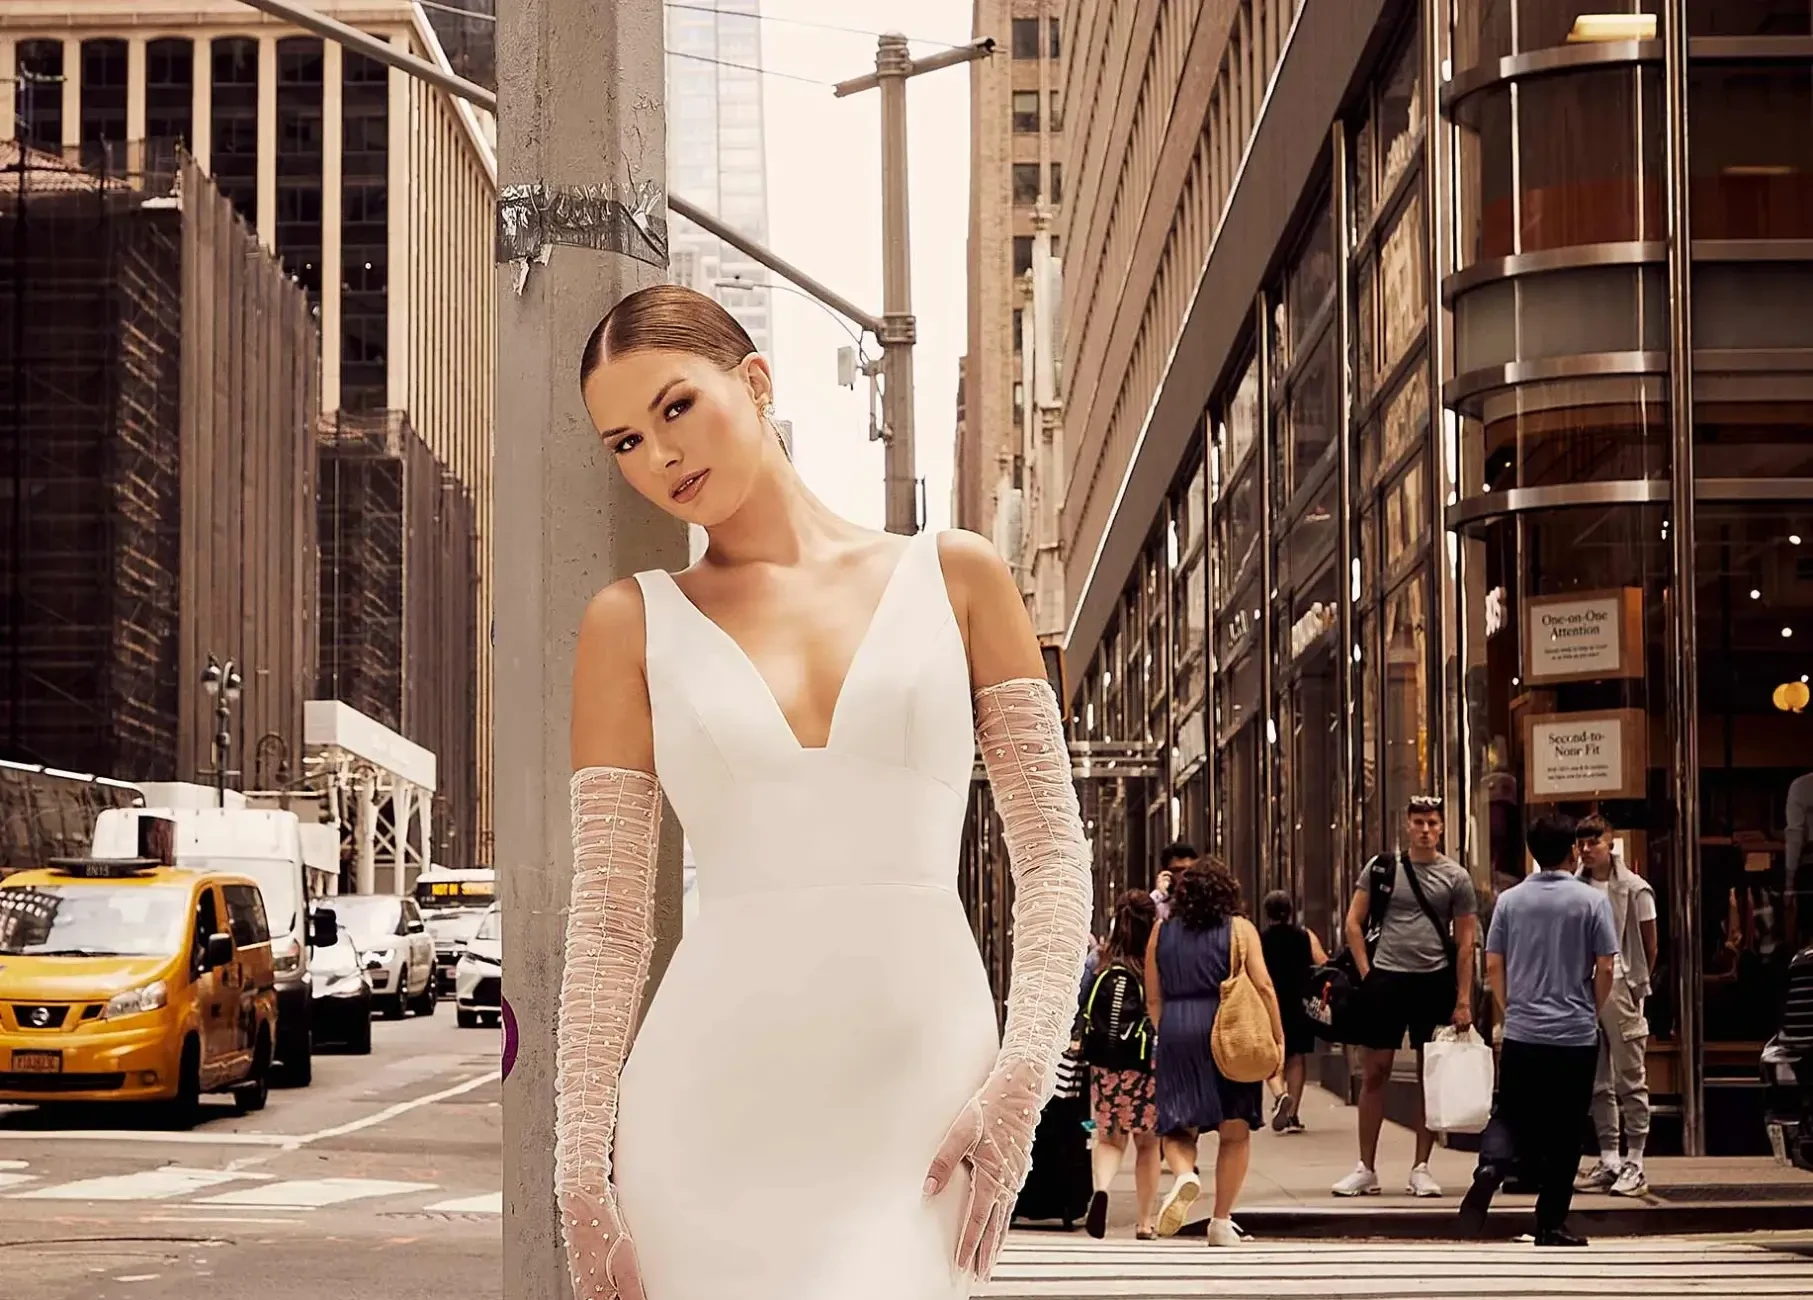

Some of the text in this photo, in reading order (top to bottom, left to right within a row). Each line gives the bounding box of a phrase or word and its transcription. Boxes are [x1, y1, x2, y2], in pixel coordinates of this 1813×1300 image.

[1542, 609, 1608, 626] One-on-One
[1550, 624, 1600, 639] Attention
[1548, 730, 1605, 744] Second-to-
[1585, 744, 1600, 756] Fit
